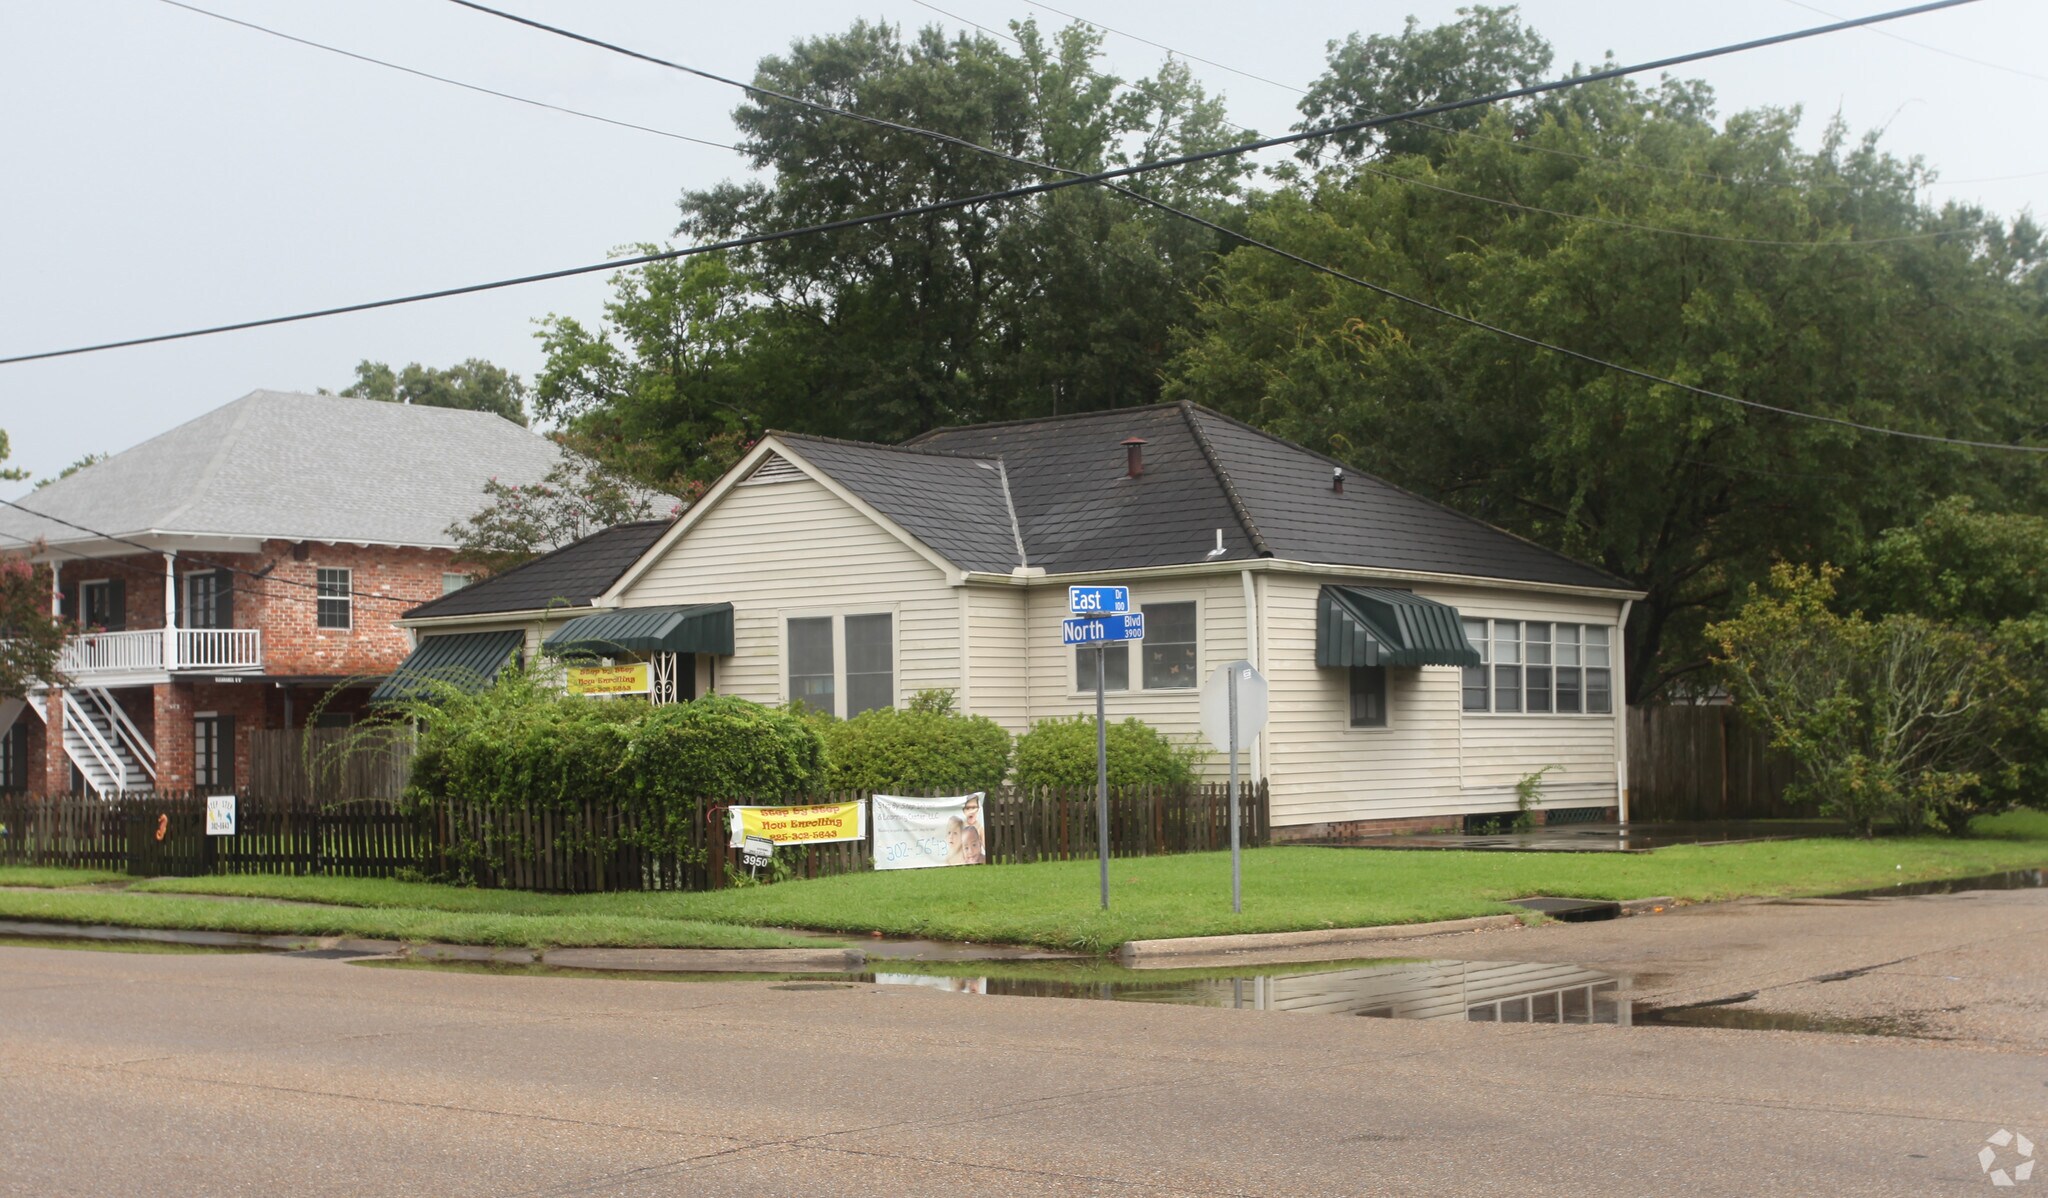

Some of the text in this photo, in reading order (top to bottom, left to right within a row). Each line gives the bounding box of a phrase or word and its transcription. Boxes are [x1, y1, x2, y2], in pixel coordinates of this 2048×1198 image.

[1072, 589, 1122, 609] East Dr
[1115, 602, 1125, 610] 100
[1065, 615, 1141, 641] North Blvd
[1125, 629, 1141, 638] 3900
[761, 805, 839, 817] Step by Step
[762, 818, 842, 830] Now Enrolling
[770, 830, 837, 841] 225-302-5643
[886, 837, 948, 861] 302-5643
[743, 855, 768, 867] 3950
